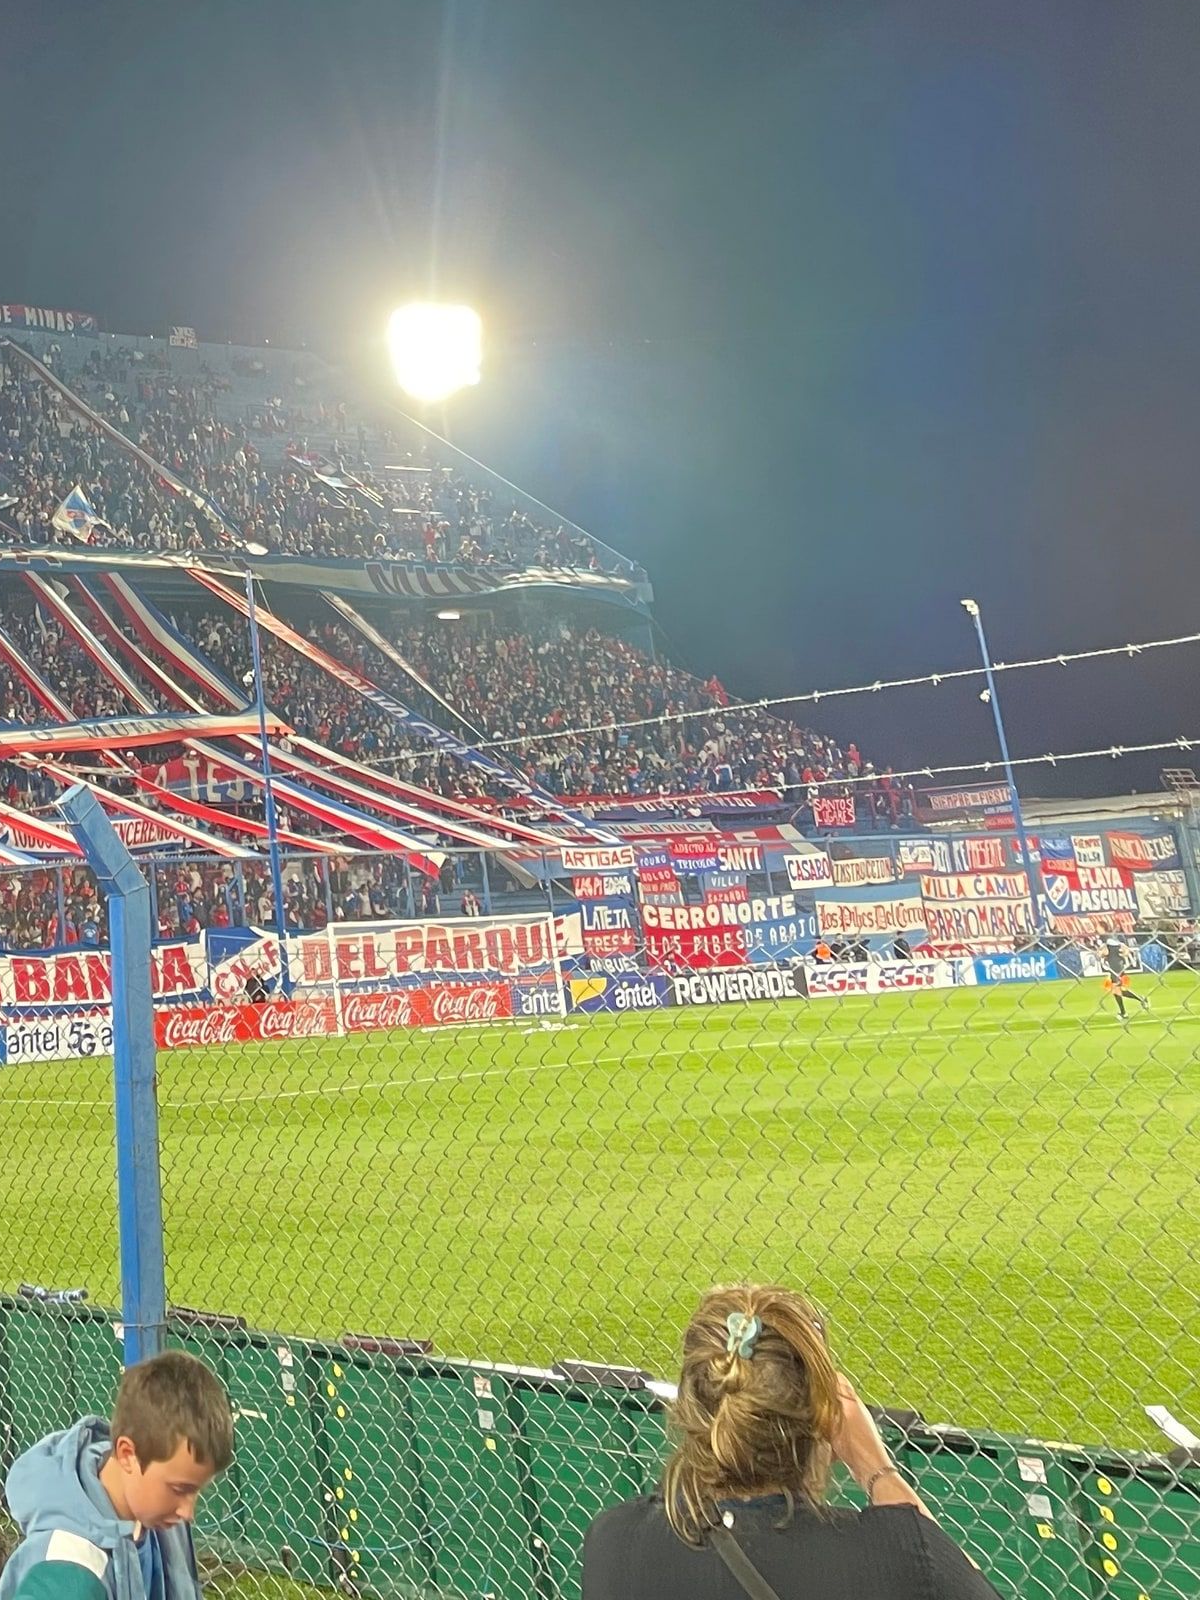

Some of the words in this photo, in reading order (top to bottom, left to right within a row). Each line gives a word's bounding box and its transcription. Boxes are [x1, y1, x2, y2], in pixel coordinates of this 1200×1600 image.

[25, 306, 76, 331] MINAS
[814, 797, 854, 812] SANTOS
[816, 809, 855, 825] LUGARES
[564, 847, 633, 867] ARTIGAS
[718, 847, 762, 872] SANTI
[923, 875, 966, 899] VILLA
[1071, 888, 1138, 912] PASCUAL
[983, 957, 1046, 980] Tenfield
[615, 982, 657, 1008] antel
[675, 972, 799, 1005] POWERADE
[7, 1024, 60, 1055] antel
